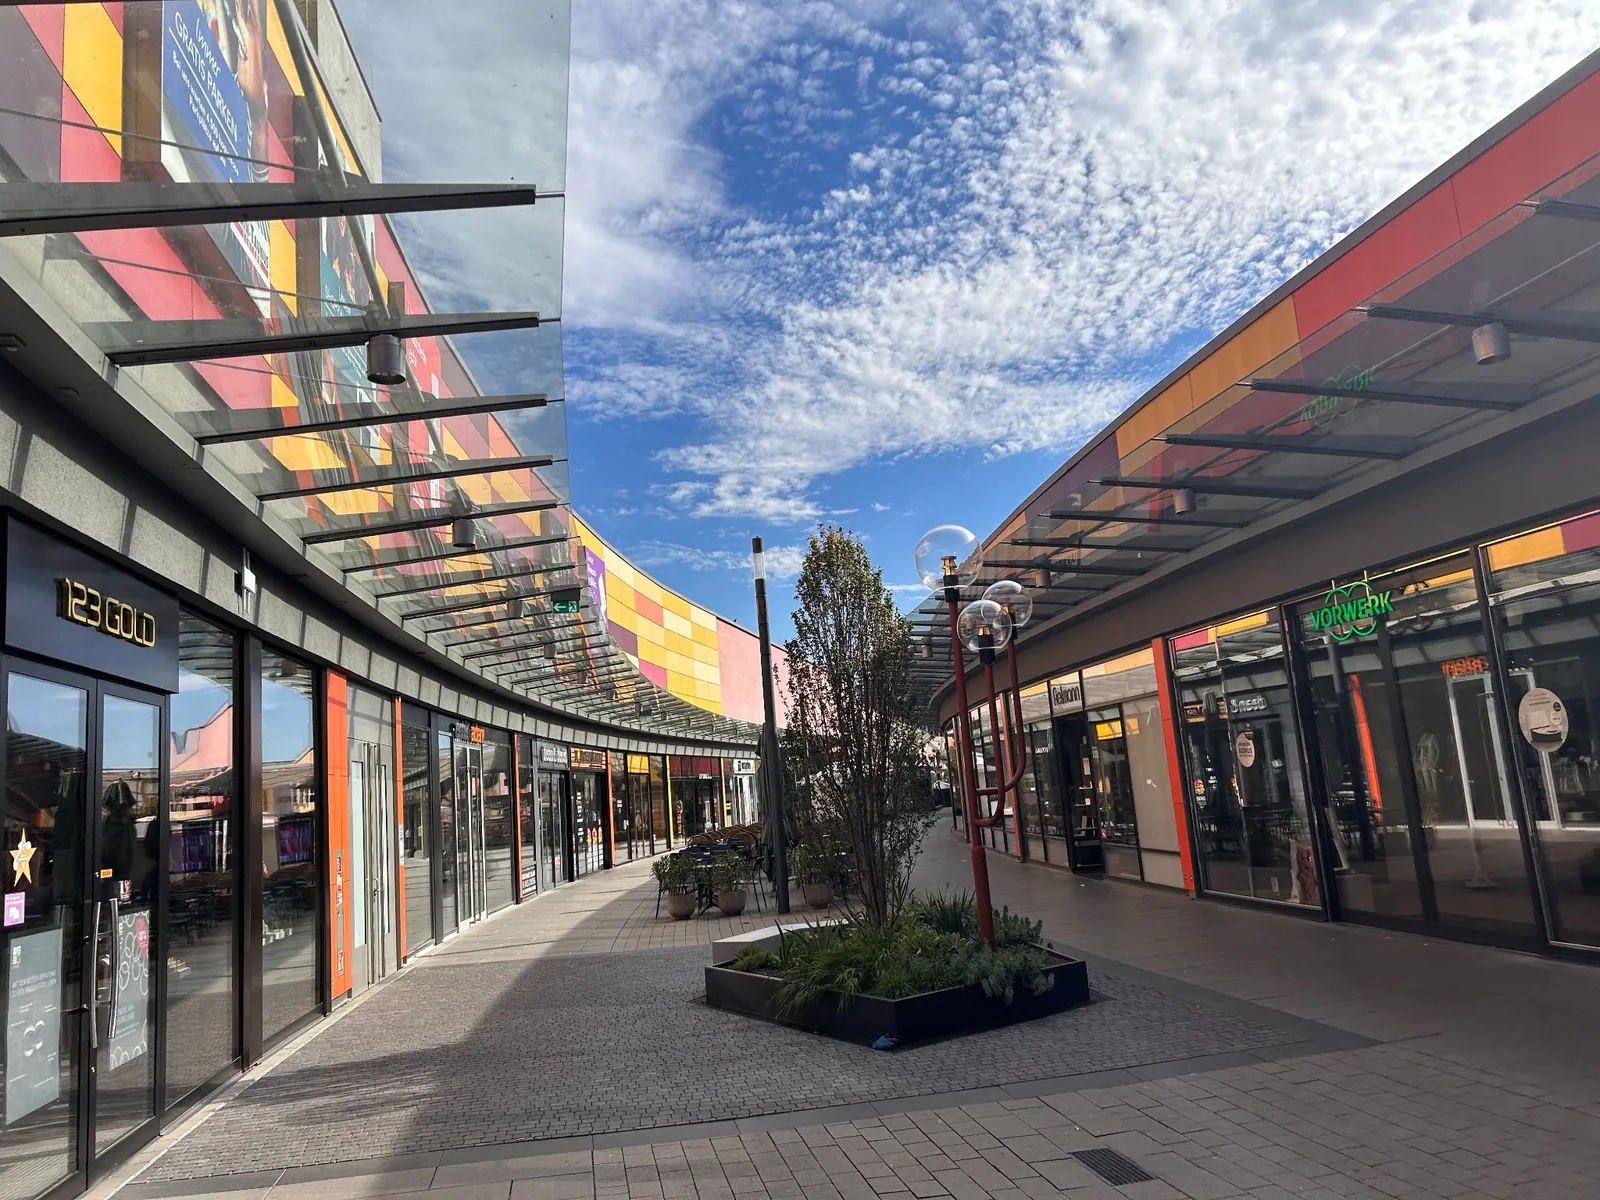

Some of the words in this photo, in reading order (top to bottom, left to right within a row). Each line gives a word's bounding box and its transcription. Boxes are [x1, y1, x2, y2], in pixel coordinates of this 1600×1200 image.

[175, 11, 206, 81] GRATIS
[207, 70, 238, 142] PARKEN
[195, 17, 221, 78] Immer
[1309, 590, 1394, 630] VORWERK
